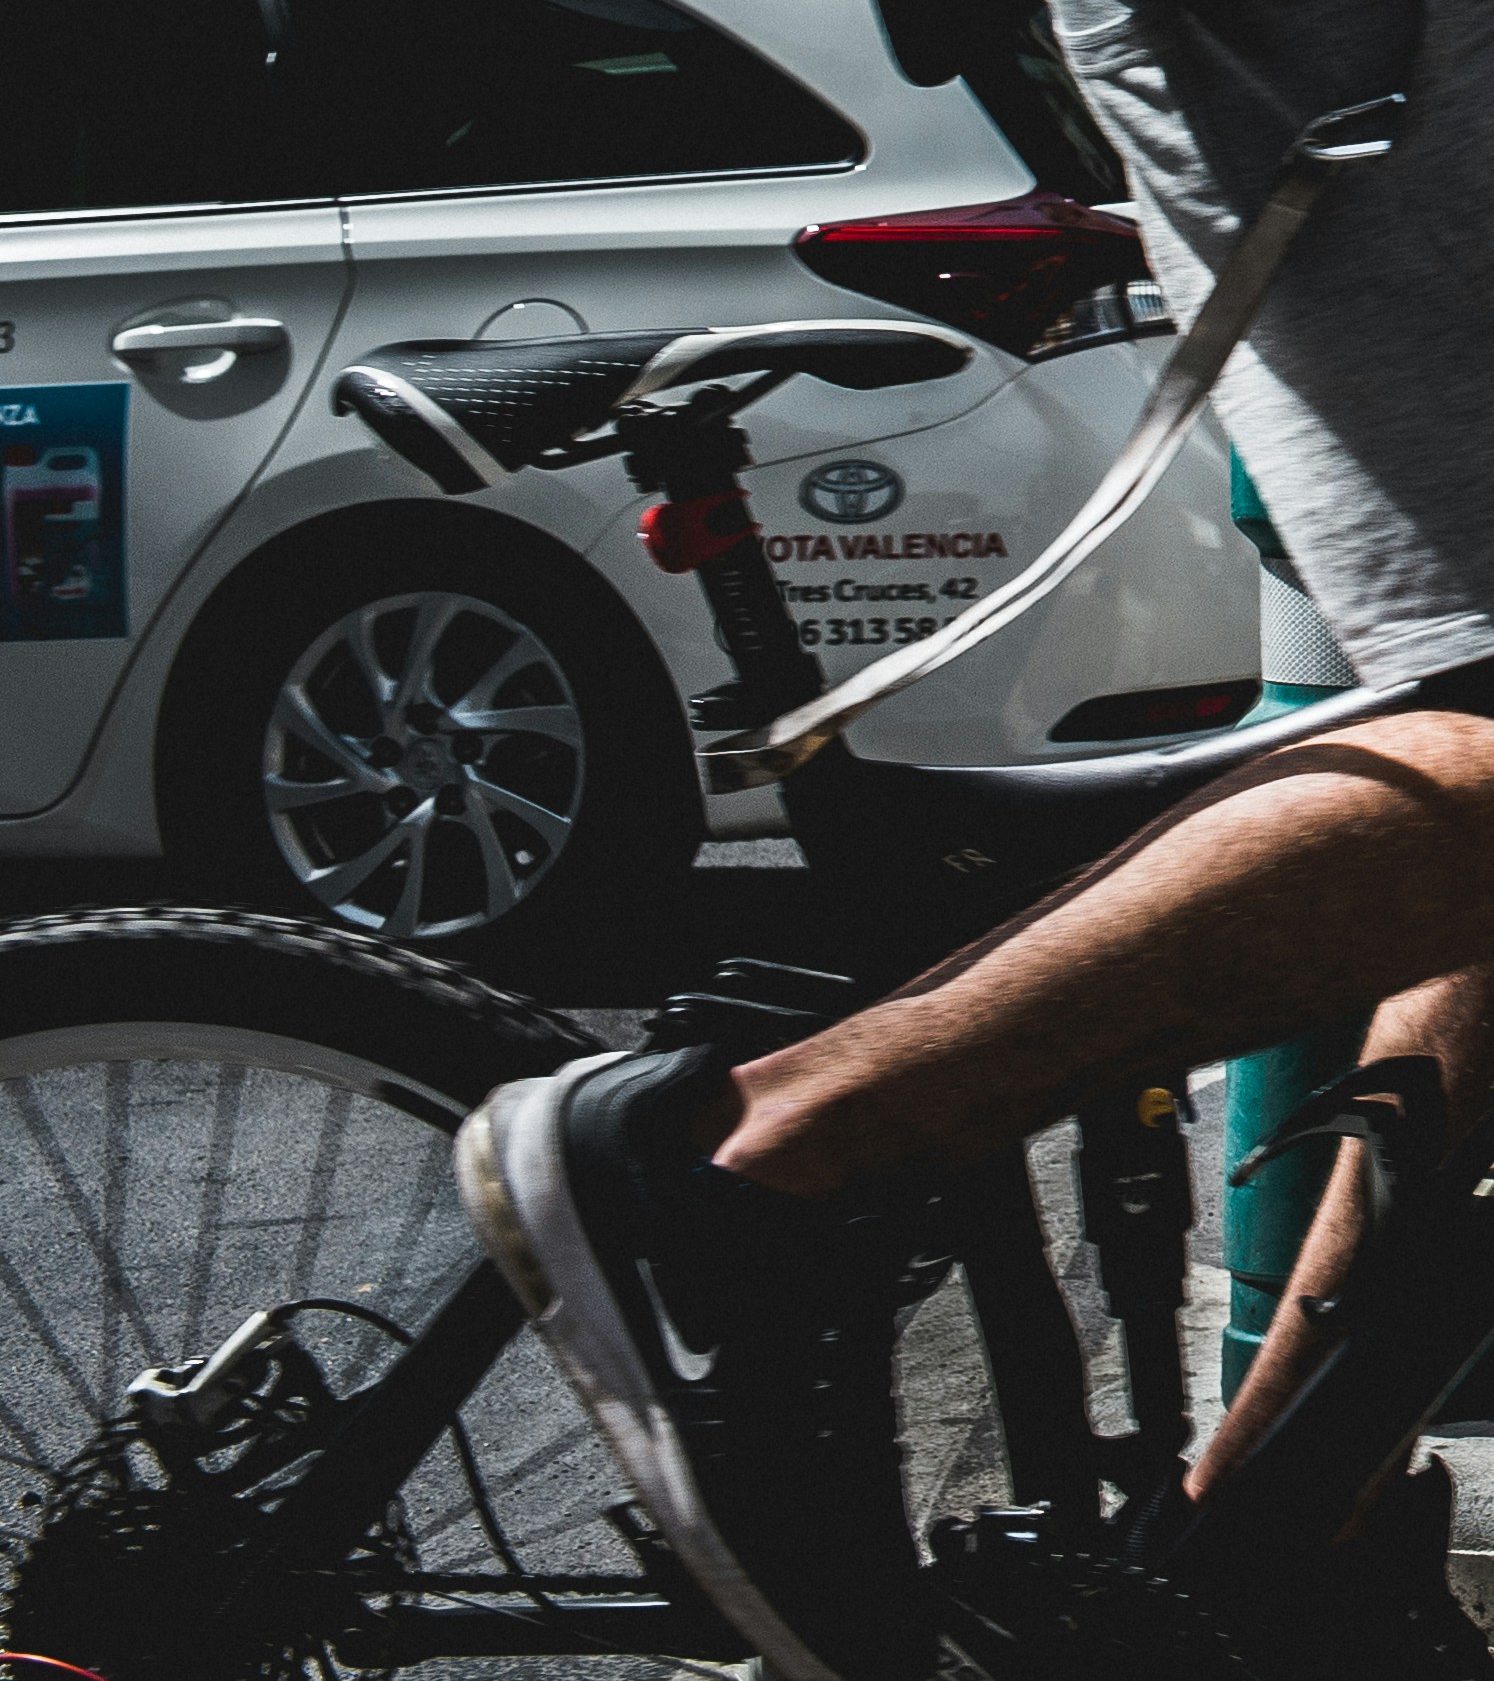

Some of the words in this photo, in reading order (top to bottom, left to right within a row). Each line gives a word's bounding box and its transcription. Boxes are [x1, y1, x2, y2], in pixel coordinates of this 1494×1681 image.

[759, 534, 837, 562] OTA
[836, 532, 1009, 560] VALENCIA
[776, 579, 831, 603] Tres
[833, 578, 936, 604] Cruces,
[938, 576, 980, 600] 42
[800, 619, 823, 646] 6
[825, 618, 889, 645] 313
